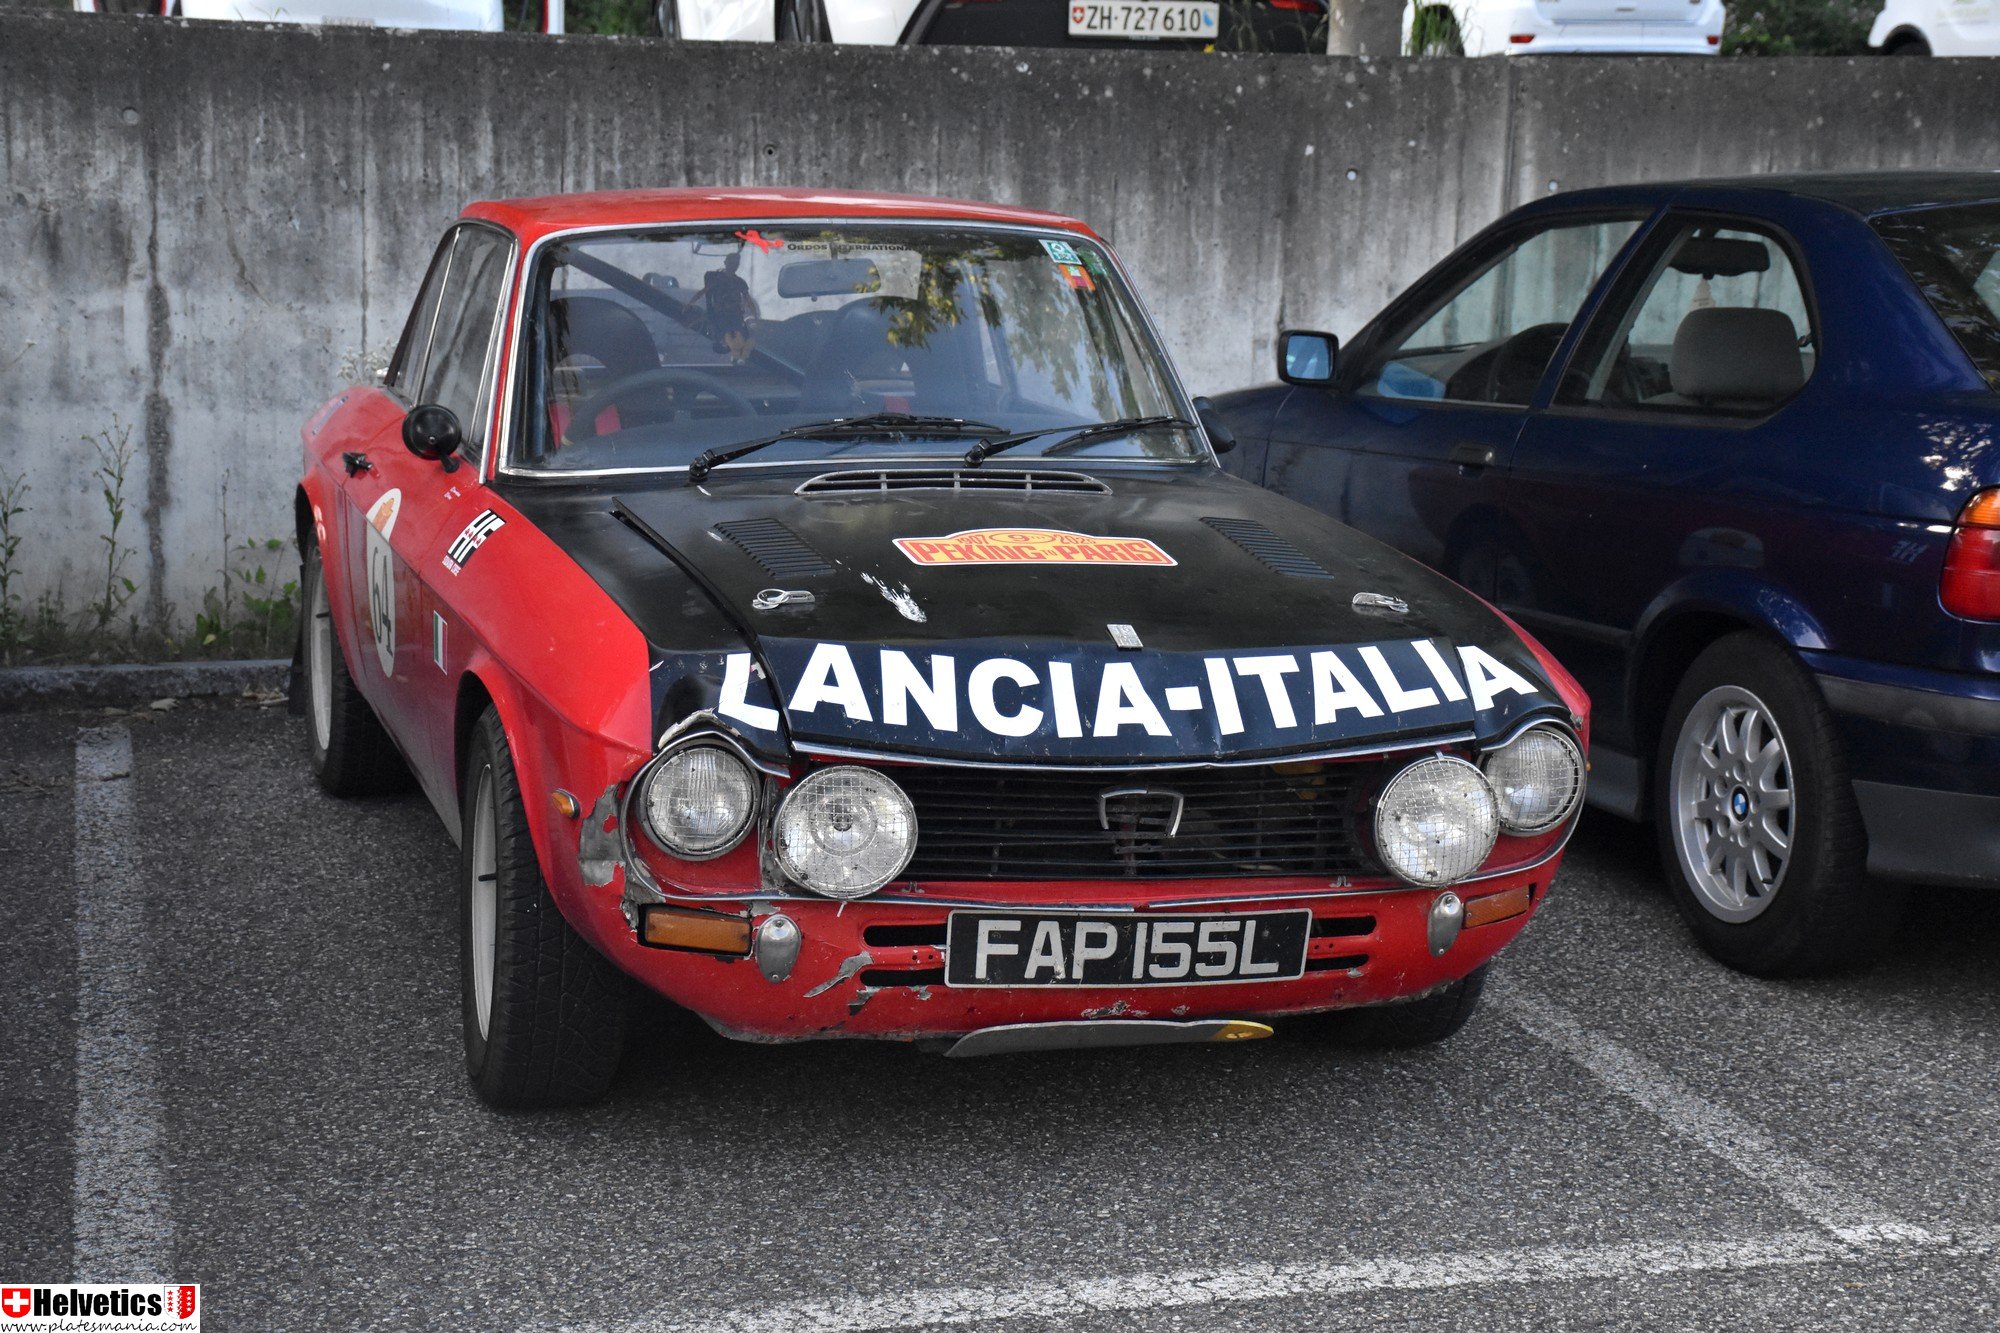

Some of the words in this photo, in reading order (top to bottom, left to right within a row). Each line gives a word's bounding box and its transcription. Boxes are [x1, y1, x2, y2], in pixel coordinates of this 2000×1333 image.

[372, 546, 394, 657] 64
[908, 541, 1049, 562] PEKING
[1054, 541, 1164, 562] PARIS
[717, 638, 1539, 739] LANCIA-ITALIA
